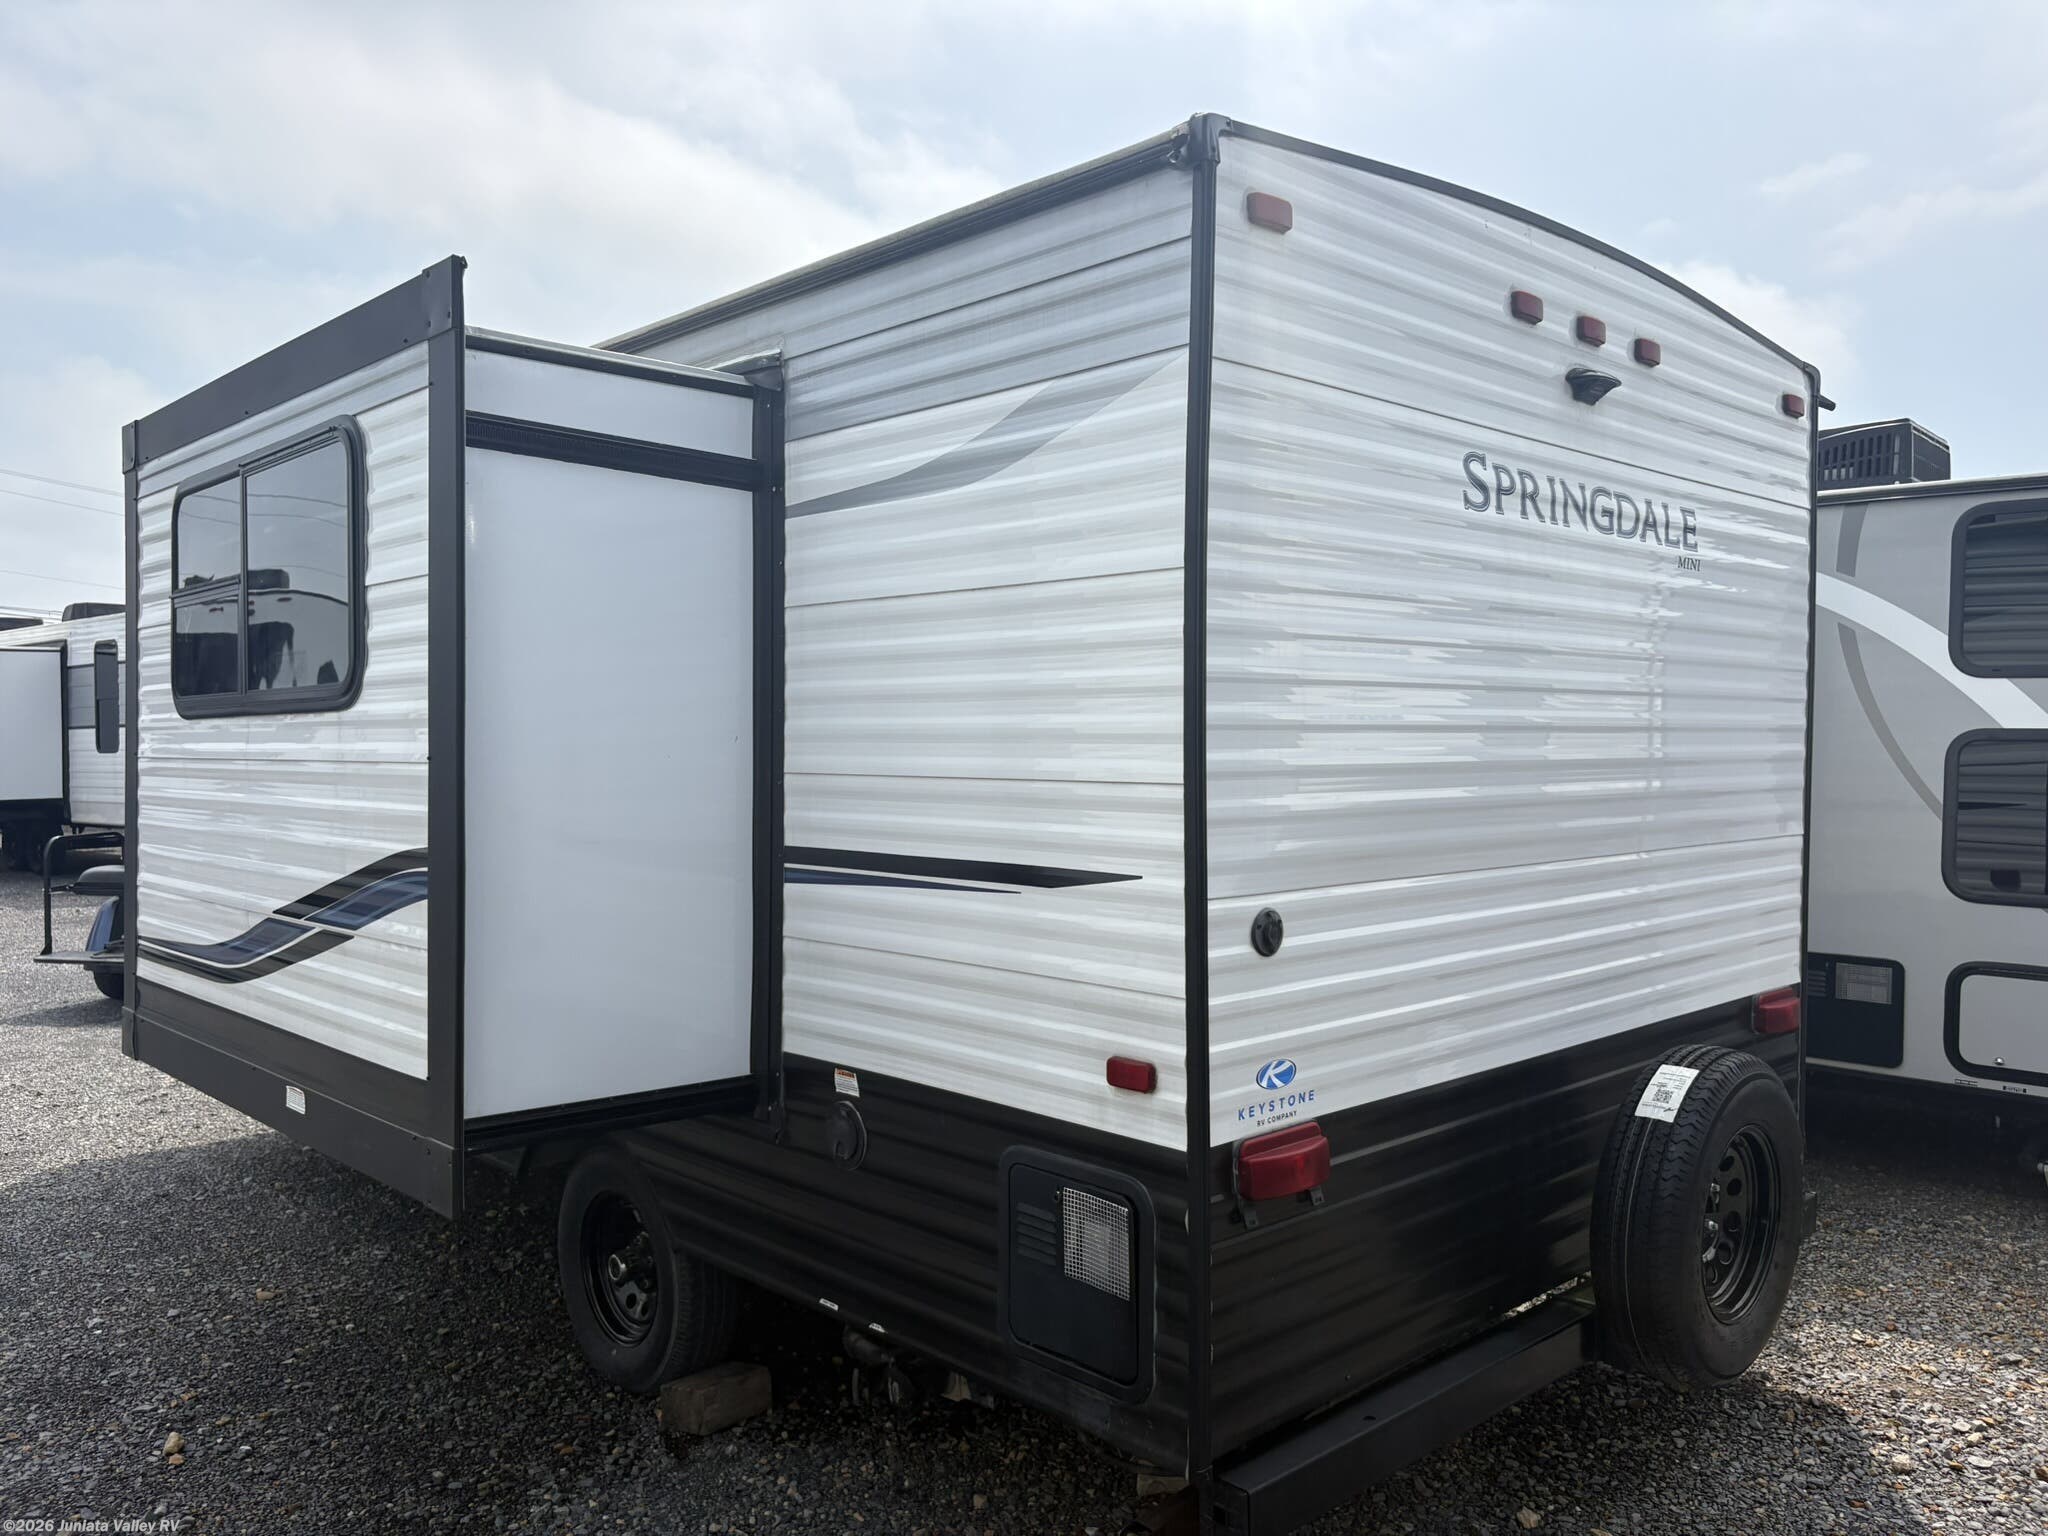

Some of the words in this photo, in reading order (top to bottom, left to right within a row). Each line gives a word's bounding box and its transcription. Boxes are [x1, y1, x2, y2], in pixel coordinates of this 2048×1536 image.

[1462, 451, 1698, 552] SPRINGDALE
[1677, 555, 1700, 572] MINI
[1238, 1090, 1315, 1120] KEYSTONE
[1267, 1110, 1297, 1124] COMPANY
